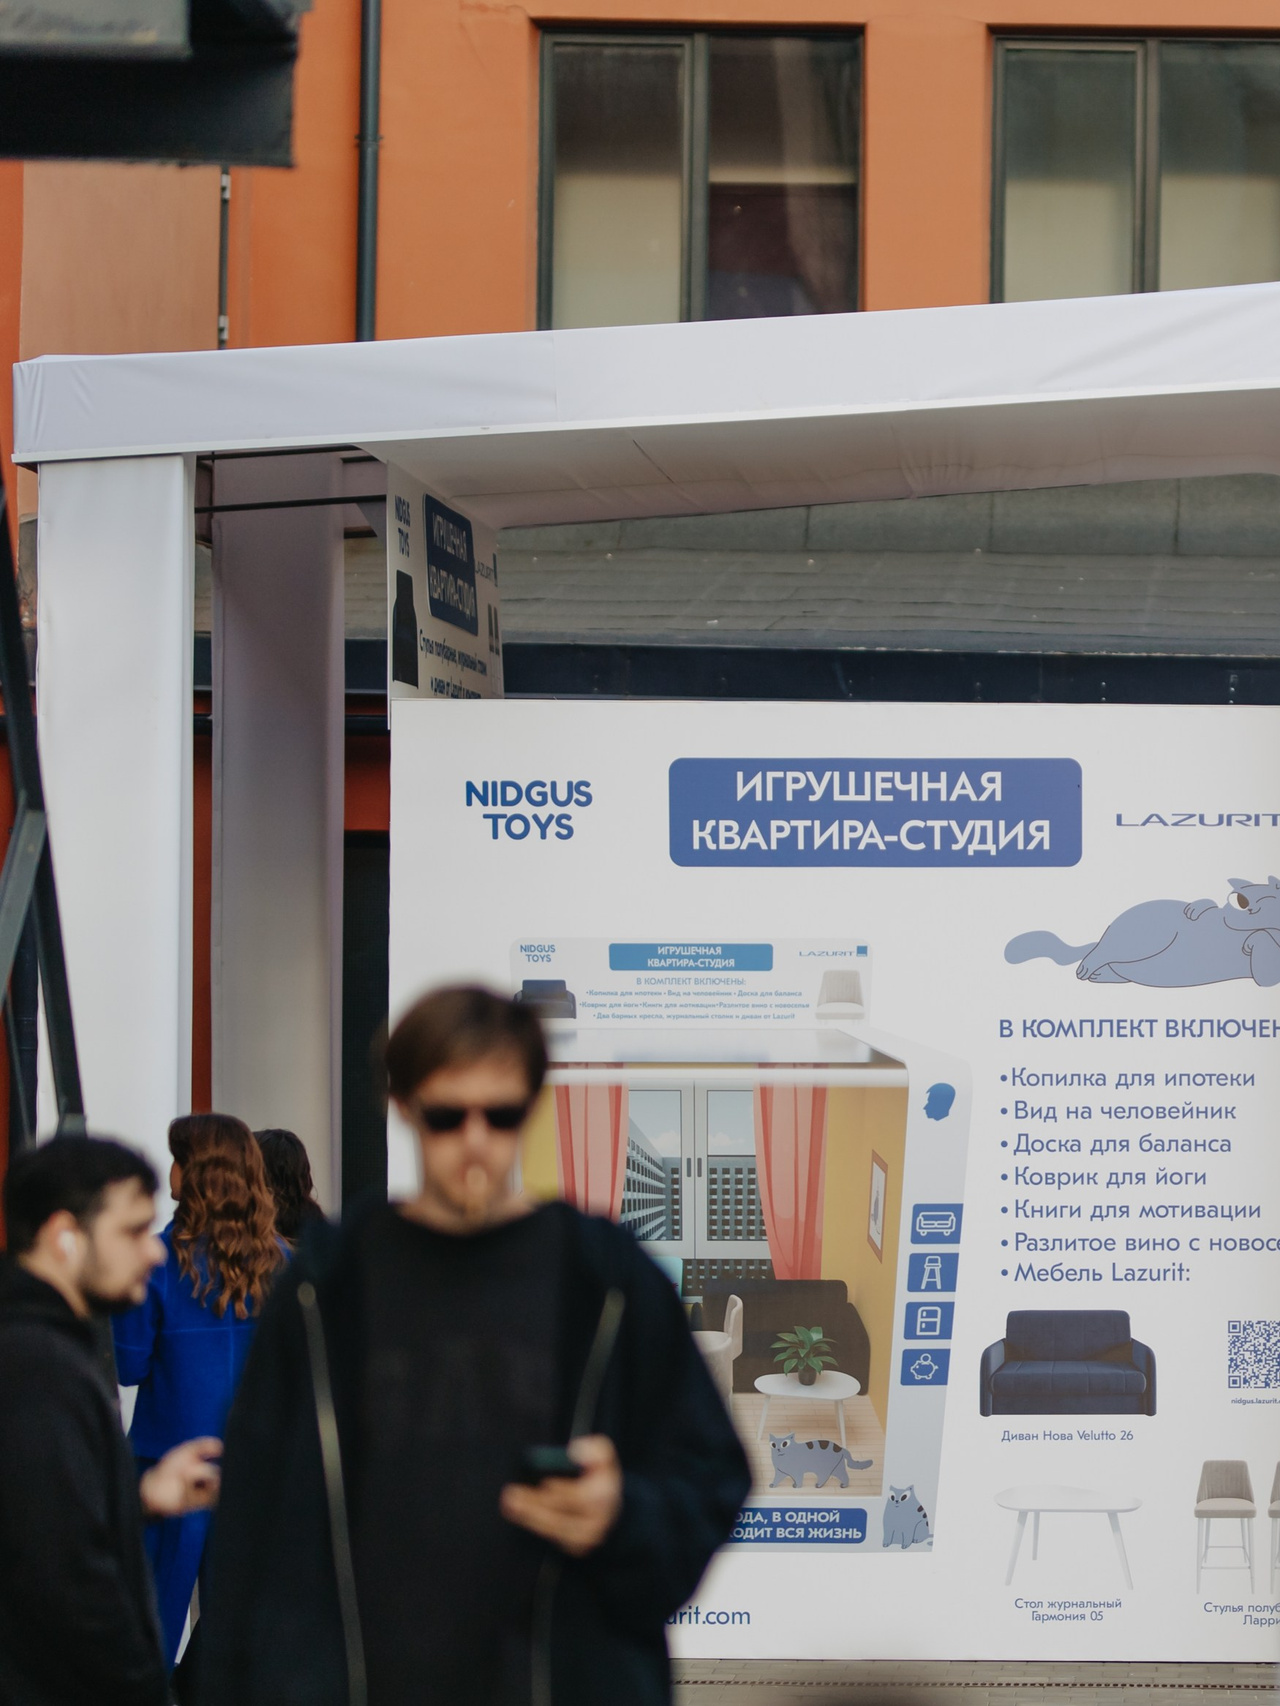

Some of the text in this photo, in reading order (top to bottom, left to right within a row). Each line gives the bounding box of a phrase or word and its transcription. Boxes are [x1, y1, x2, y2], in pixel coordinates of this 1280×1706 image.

[466, 780, 593, 807] NIDGUS
[736, 771, 1002, 802] ИГРУШЕЧНАЯ
[482, 813, 574, 840] TOYS
[692, 820, 1050, 856] КВАРТИРА-СТУДИЯ
[520, 944, 556, 953] NIDGUS
[657, 946, 722, 955] ИГРУШЕЧНАЯ
[526, 954, 552, 963] TOYS
[647, 959, 735, 968] КВАРТИРА-СТУДИЯ
[1000, 1020, 1013, 1038] В
[1022, 1020, 1158, 1038] КОМПЛЕКТ
[1011, 1067, 1255, 1090] Копилка для ипотеки
[1014, 1100, 1236, 1123] Вид на человейник
[1013, 1133, 1231, 1156] Доска для баланса
[1015, 1166, 1207, 1190] Коврик для йоги
[1015, 1199, 1261, 1221] Книги для мотивации
[1015, 1233, 1116, 1251] Разлитое
[1125, 1238, 1180, 1251] вино
[1189, 1238, 1200, 1251] с
[1014, 1262, 1190, 1282] Мебель Lazurit:
[1001, 1430, 1134, 1442] Диван Нова Velutto 26
[735, 1510, 840, 1524] ОДА, В ОДНОЙ
[730, 1528, 862, 1540] ОДИТ ВСЯ ЖИЗНЬ
[1014, 1598, 1122, 1611] Стол журнальный
[1204, 1602, 1244, 1616] Стулья
[666, 1605, 750, 1625] urit.com
[1031, 1611, 1103, 1624] Гармония 05
